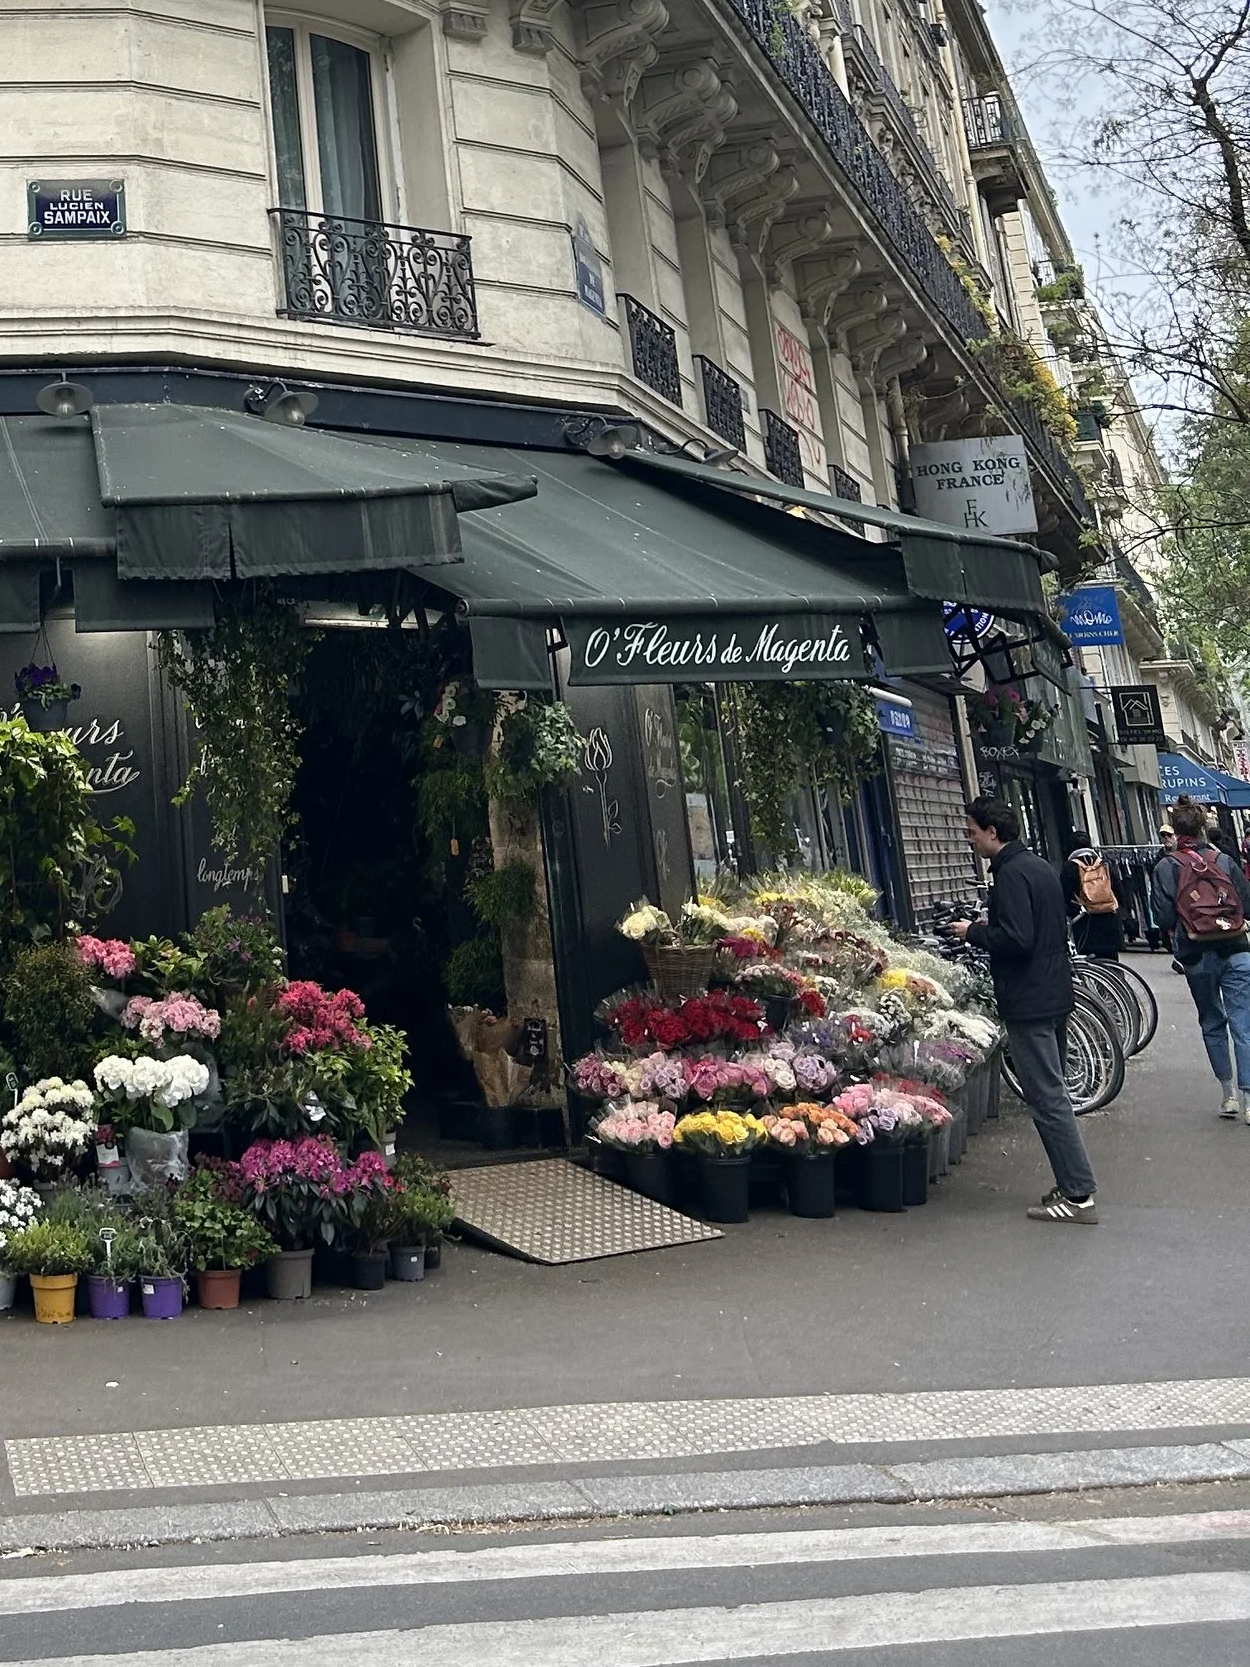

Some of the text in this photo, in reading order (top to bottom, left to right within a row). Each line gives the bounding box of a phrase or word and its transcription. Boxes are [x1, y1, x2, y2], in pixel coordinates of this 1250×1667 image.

[60, 189, 93, 201] RUE
[50, 202, 104, 210] LUCIEN
[44, 211, 110, 224] SAMPAIX
[916, 456, 1021, 477] HONG KONG
[936, 474, 1005, 490] FRANCE
[584, 621, 851, 674] O'Fleurs de Magenta
